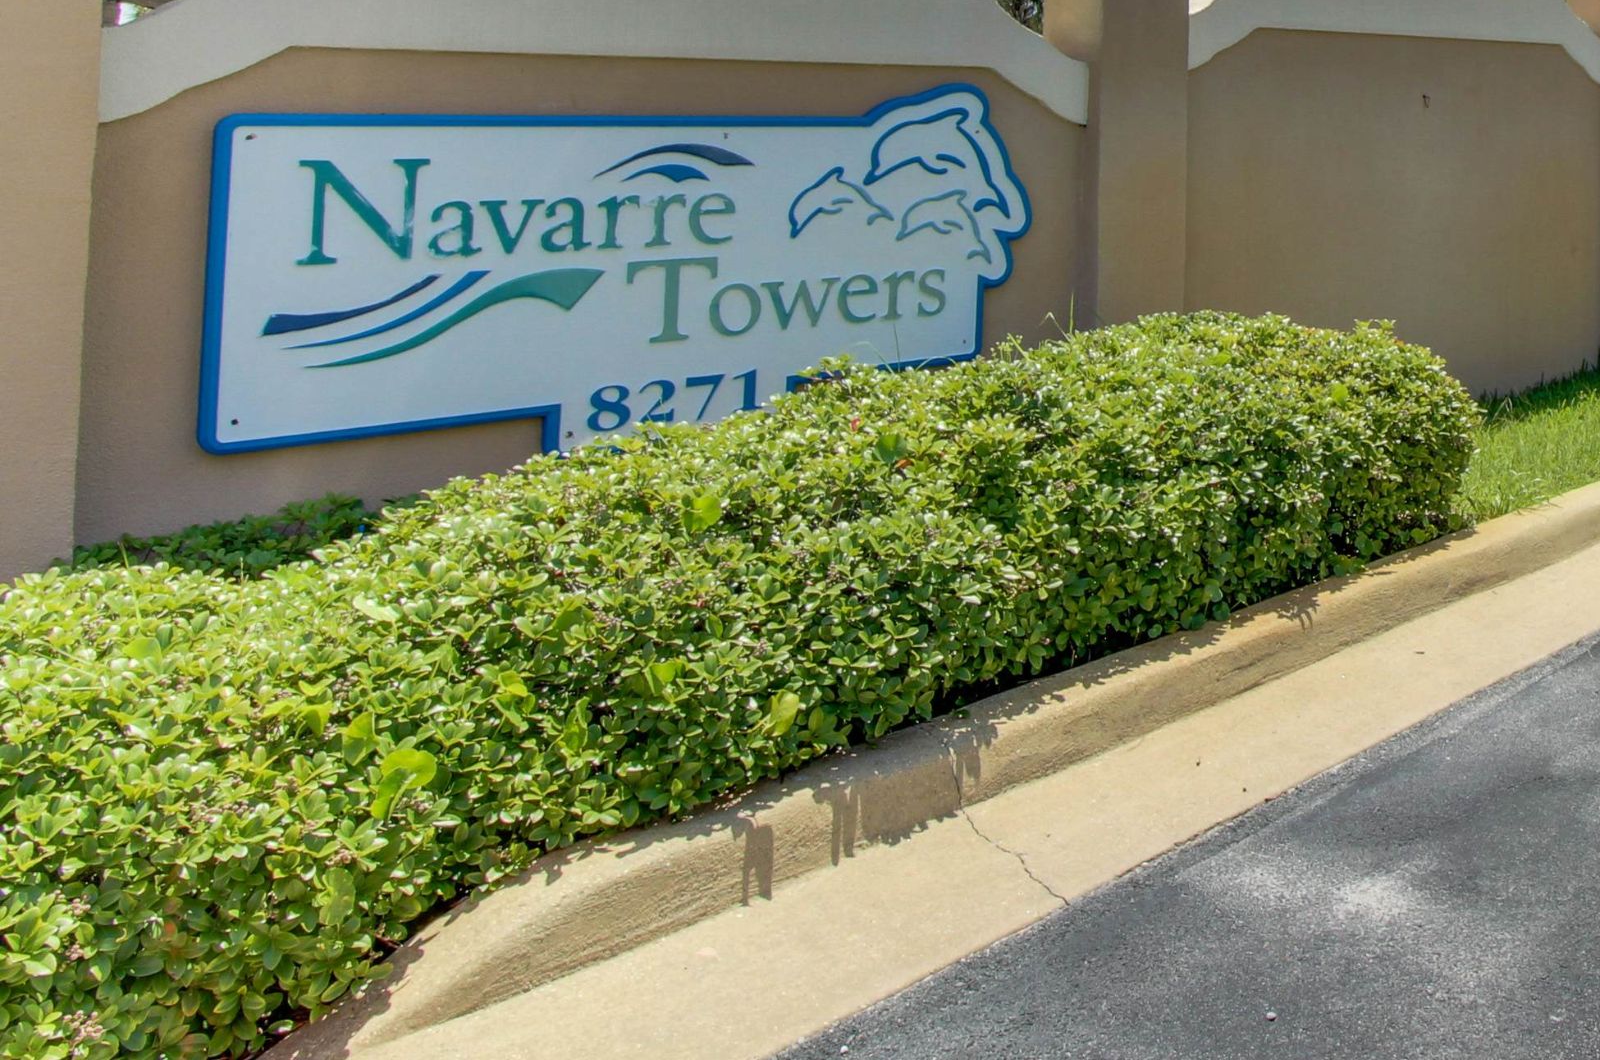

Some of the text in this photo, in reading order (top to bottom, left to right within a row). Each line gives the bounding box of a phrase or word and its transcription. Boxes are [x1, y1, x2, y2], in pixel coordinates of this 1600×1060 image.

[297, 157, 737, 267] Navarre
[626, 256, 947, 344] Towers
[586, 368, 763, 432] 8271
